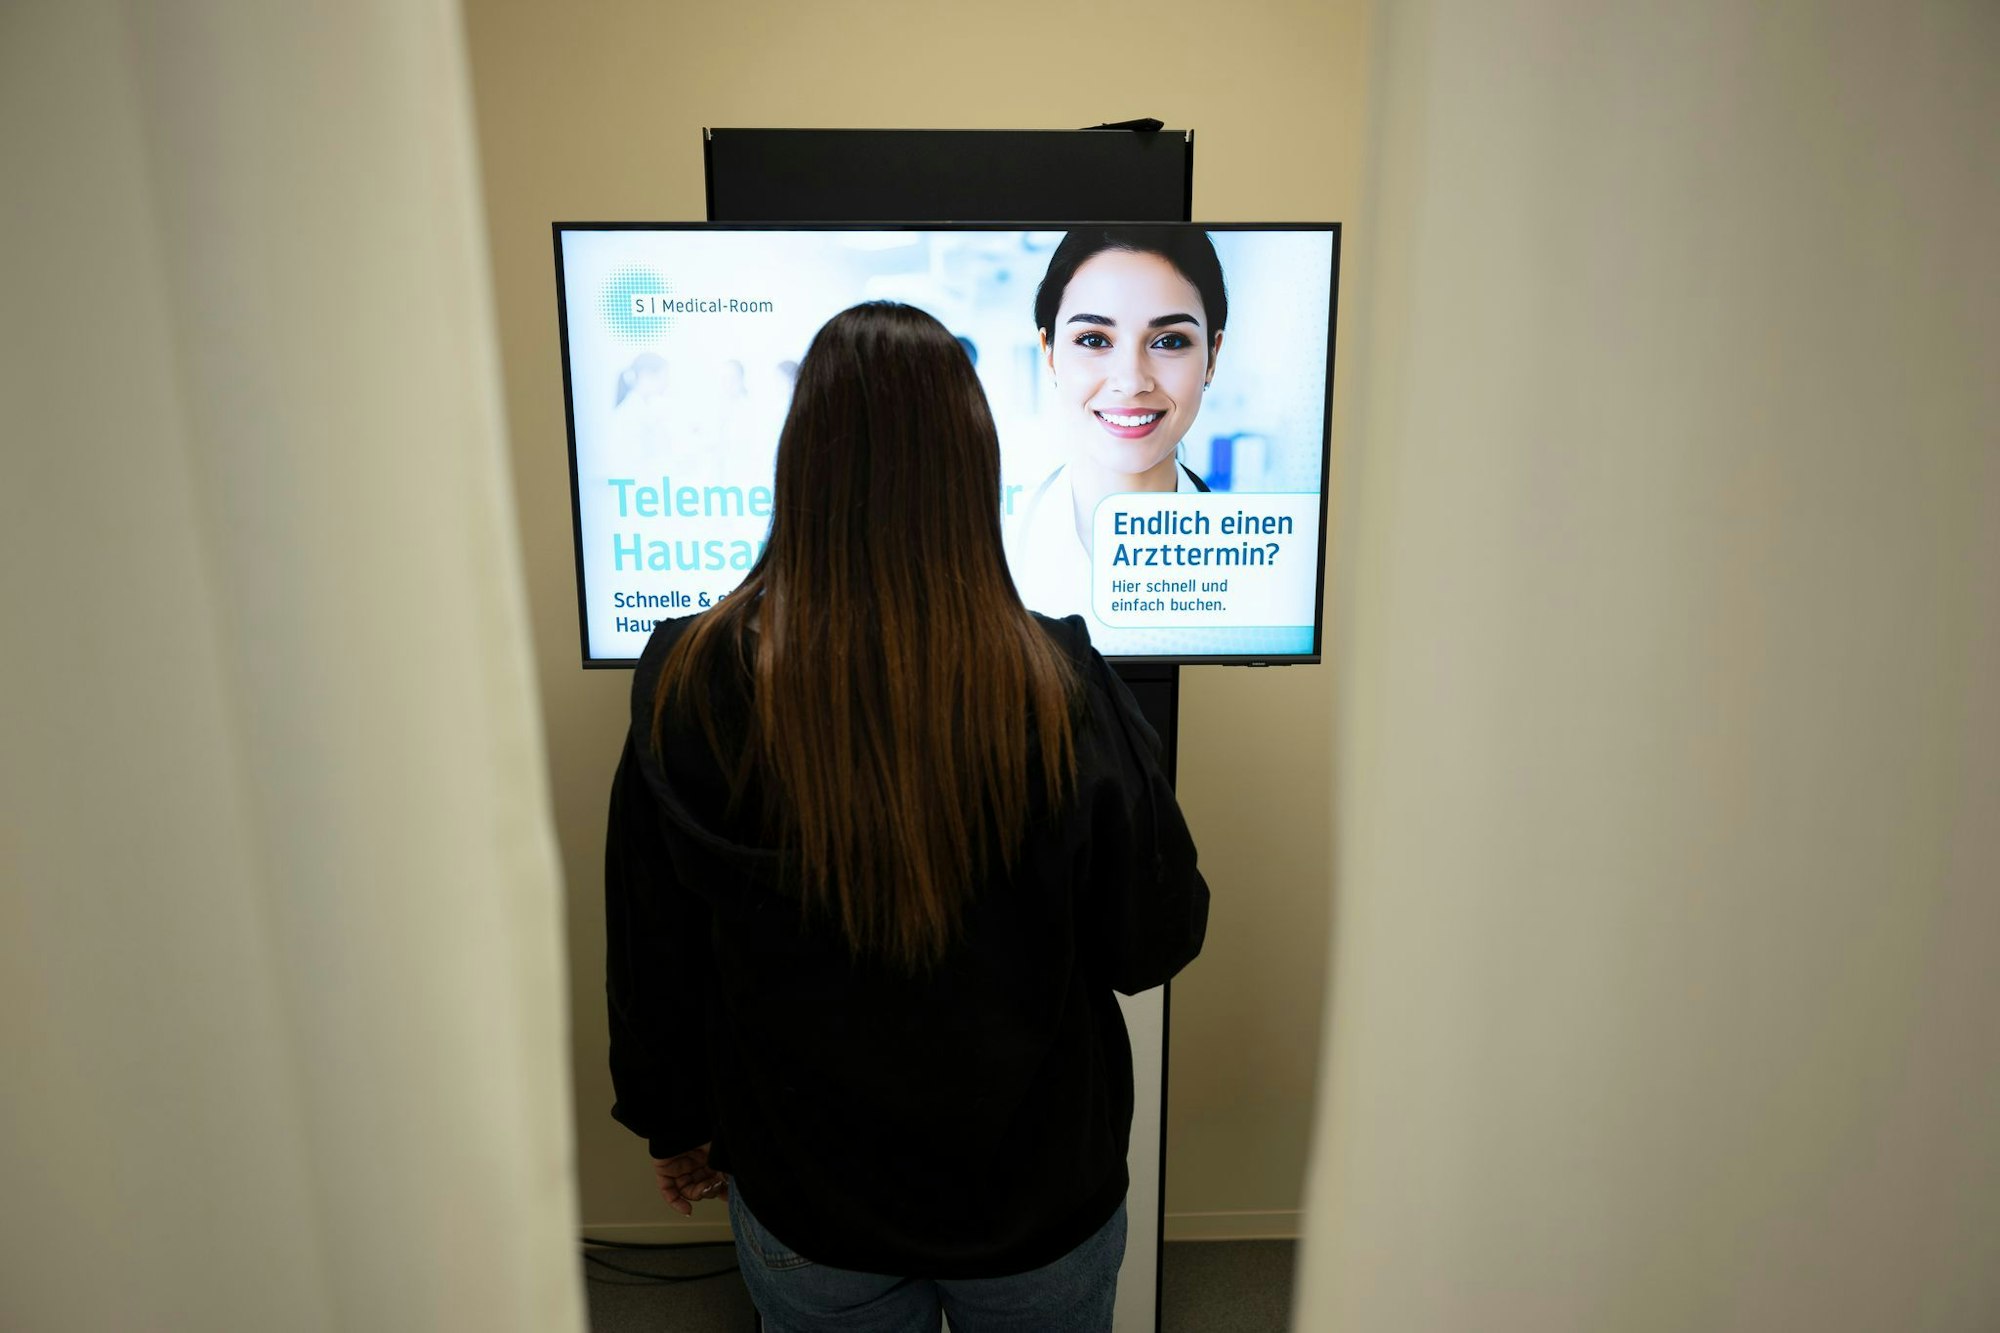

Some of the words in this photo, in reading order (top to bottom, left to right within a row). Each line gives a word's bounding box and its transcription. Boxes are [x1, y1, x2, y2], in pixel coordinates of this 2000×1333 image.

[635, 298, 645, 313] S
[662, 298, 773, 313] Medical-Room
[608, 476, 772, 518] Teleme
[1114, 510, 1210, 535] Endlich
[1221, 510, 1293, 535] einen
[613, 533, 769, 571] Hausa
[1112, 541, 1280, 566] Arzttermin?
[1112, 580, 1141, 593] Hier
[1146, 579, 1196, 593] schnell
[1201, 579, 1228, 593] und
[614, 591, 691, 608] Schnelle
[698, 591, 711, 608] &
[1111, 598, 1165, 612] einfach
[1170, 598, 1226, 612] buchen.
